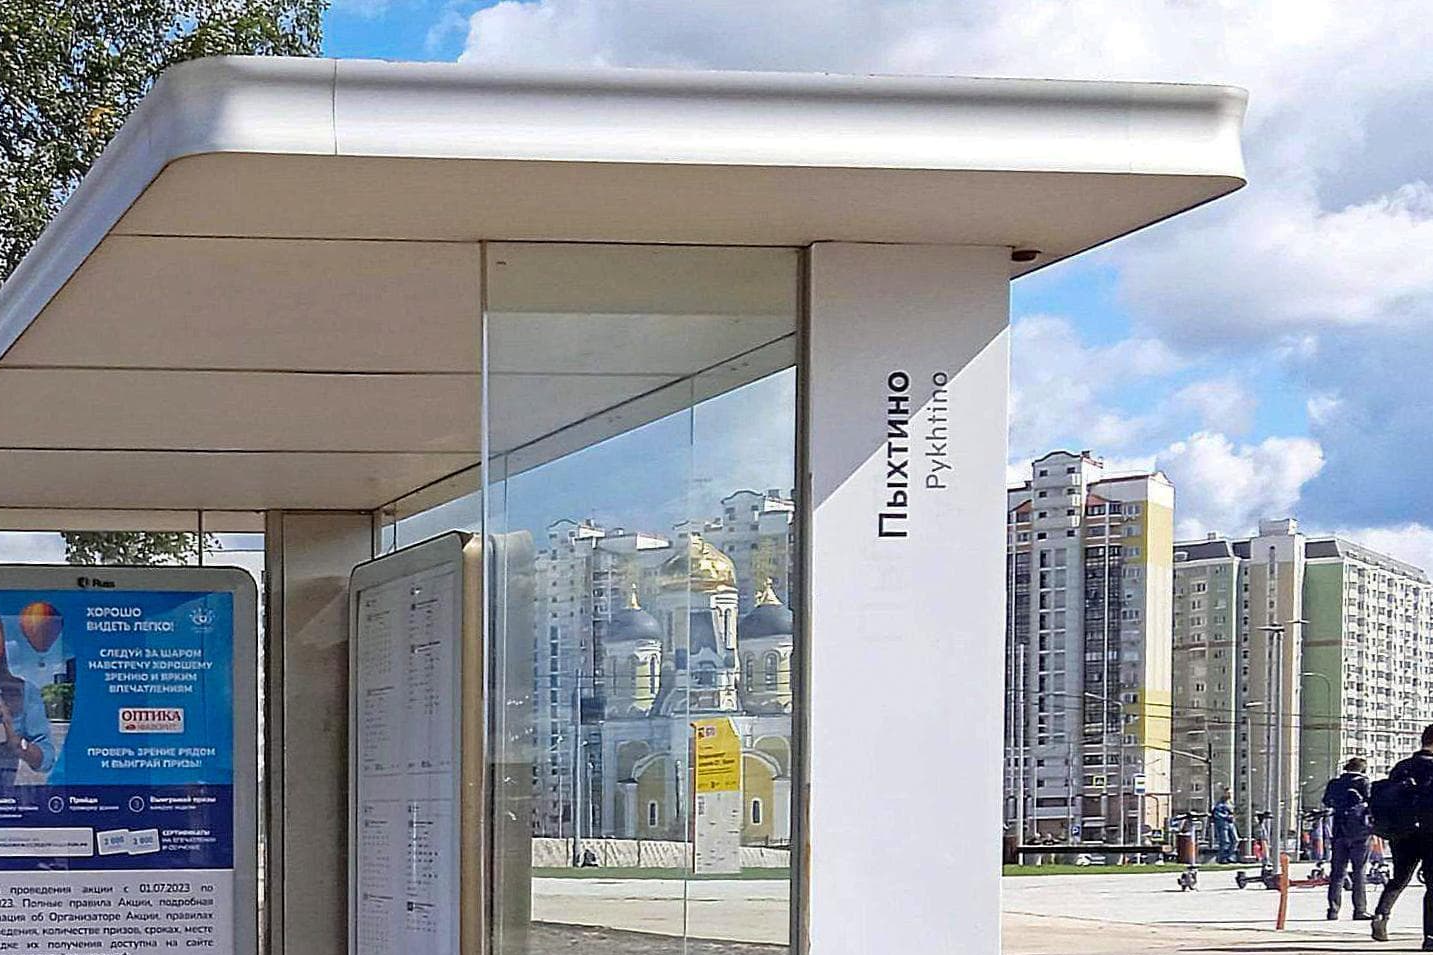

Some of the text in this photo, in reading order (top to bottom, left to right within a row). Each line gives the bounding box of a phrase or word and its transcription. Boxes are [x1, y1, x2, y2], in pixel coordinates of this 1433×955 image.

[925, 372, 952, 489] Pykhtino
[878, 371, 910, 538] Пыхтино
[86, 607, 142, 618] ХОРОШО
[86, 621, 175, 632] ВИДЕТЬ ЛЕГКО!
[99, 647, 202, 659] СЛЕДУЙ ЗА ШАРОМ
[88, 661, 213, 670] НАВСТРЕЧУ ХОРОШЕМУ
[104, 673, 149, 682] ЗРЕНИЮ
[151, 673, 159, 681] И
[109, 684, 193, 693] ВПЕЧАТЛЕНИЯМ
[121, 710, 182, 722] ОПТИКА
[87, 747, 216, 758] ПРОВЕРЬ ЗРЕНИЕ РЯДОМ
[101, 760, 109, 768] И
[111, 759, 161, 768] ВЫИГРАЙ
[10, 887, 72, 895] проведения
[82, 886, 114, 894] акции
[139, 884, 191, 893] 01.07.2023
[23, 898, 64, 908] Полные
[69, 899, 112, 908] правила
[159, 897, 214, 907] подробная
[31, 912, 44, 921] об
[49, 911, 121, 922] Организаторе
[166, 912, 214, 921] правилах
[43, 927, 101, 936] количестве
[47, 941, 103, 950] получения
[110, 940, 158, 949] доступна
[186, 938, 214, 947] сайте
